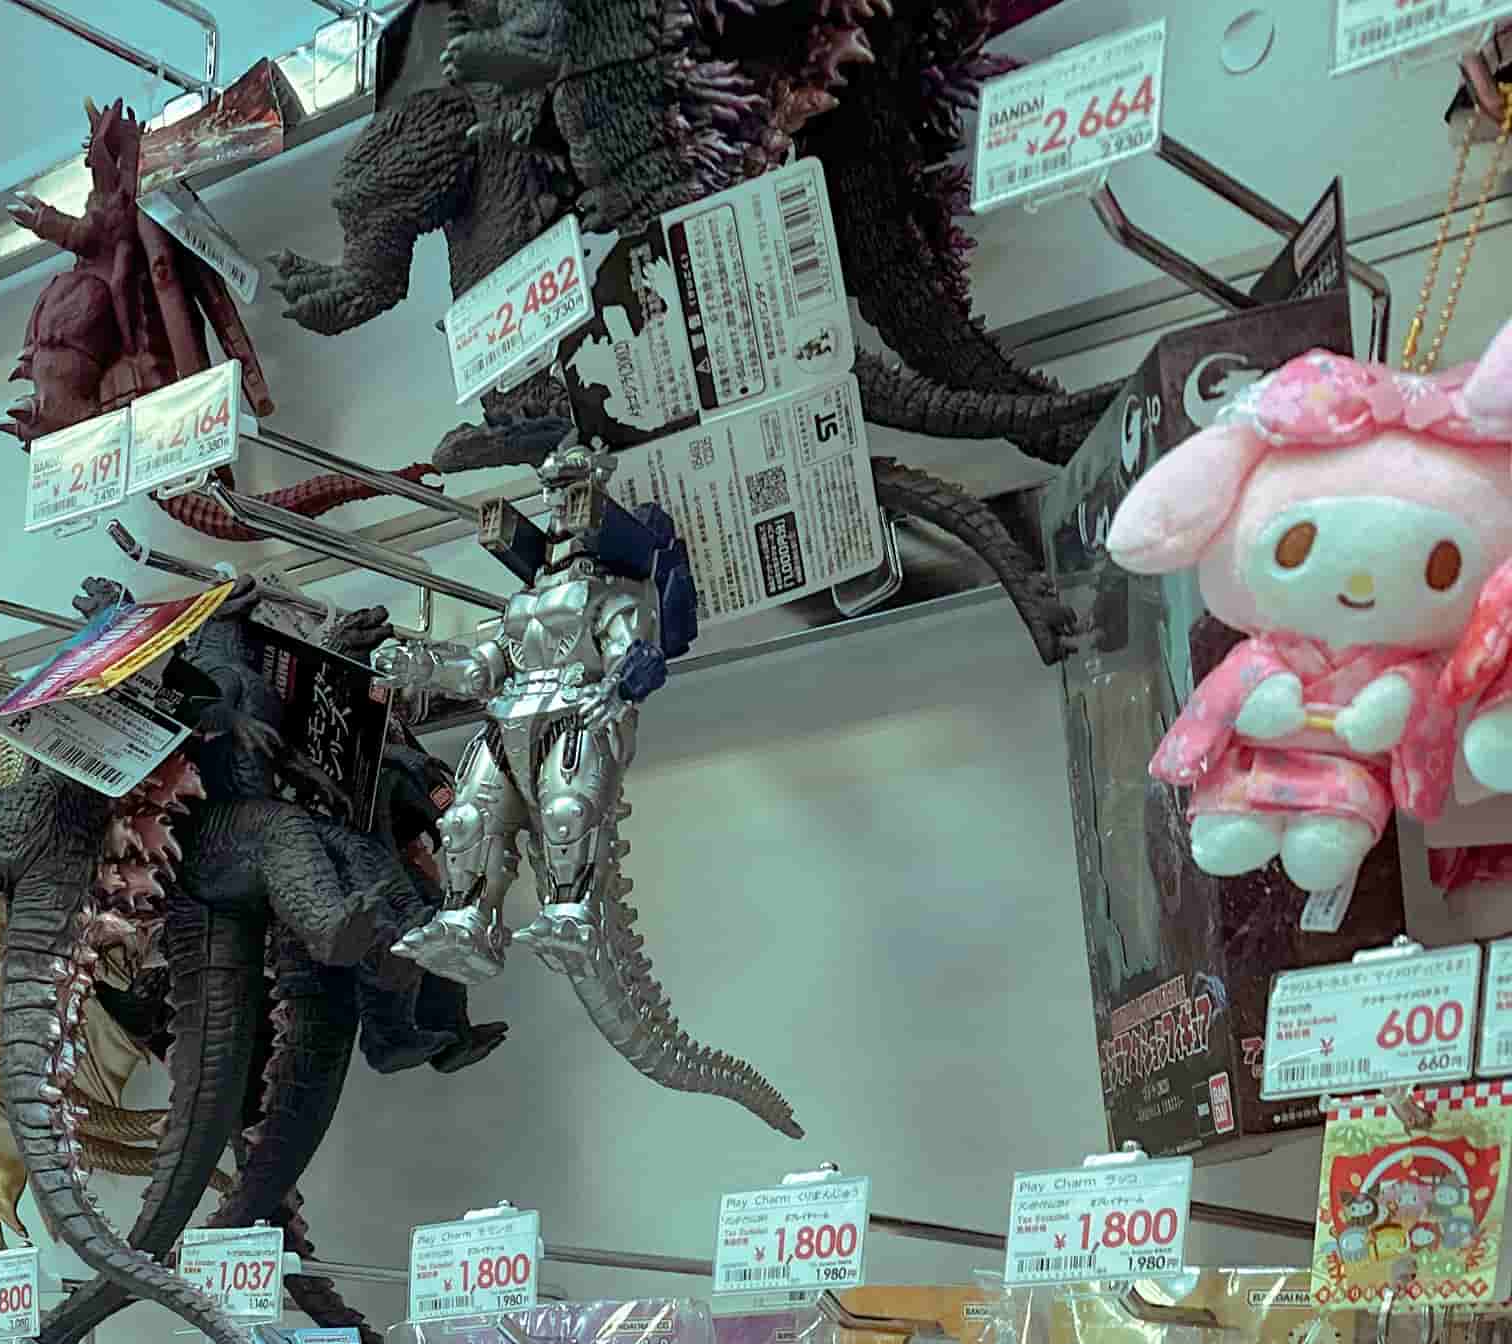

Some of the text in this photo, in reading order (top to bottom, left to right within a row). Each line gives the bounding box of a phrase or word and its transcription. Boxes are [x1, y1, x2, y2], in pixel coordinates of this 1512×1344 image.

[169, 398, 231, 447] 2,164
[70, 450, 123, 492] 2,191
[1376, 1000, 1464, 1050] 600
[1054, 1176, 1097, 1190] Charm
[776, 1223, 858, 1265] 1,800
[1080, 1207, 1178, 1254] 1,800
[219, 1260, 276, 1303] 1,037
[460, 1253, 531, 1295] 1,800
